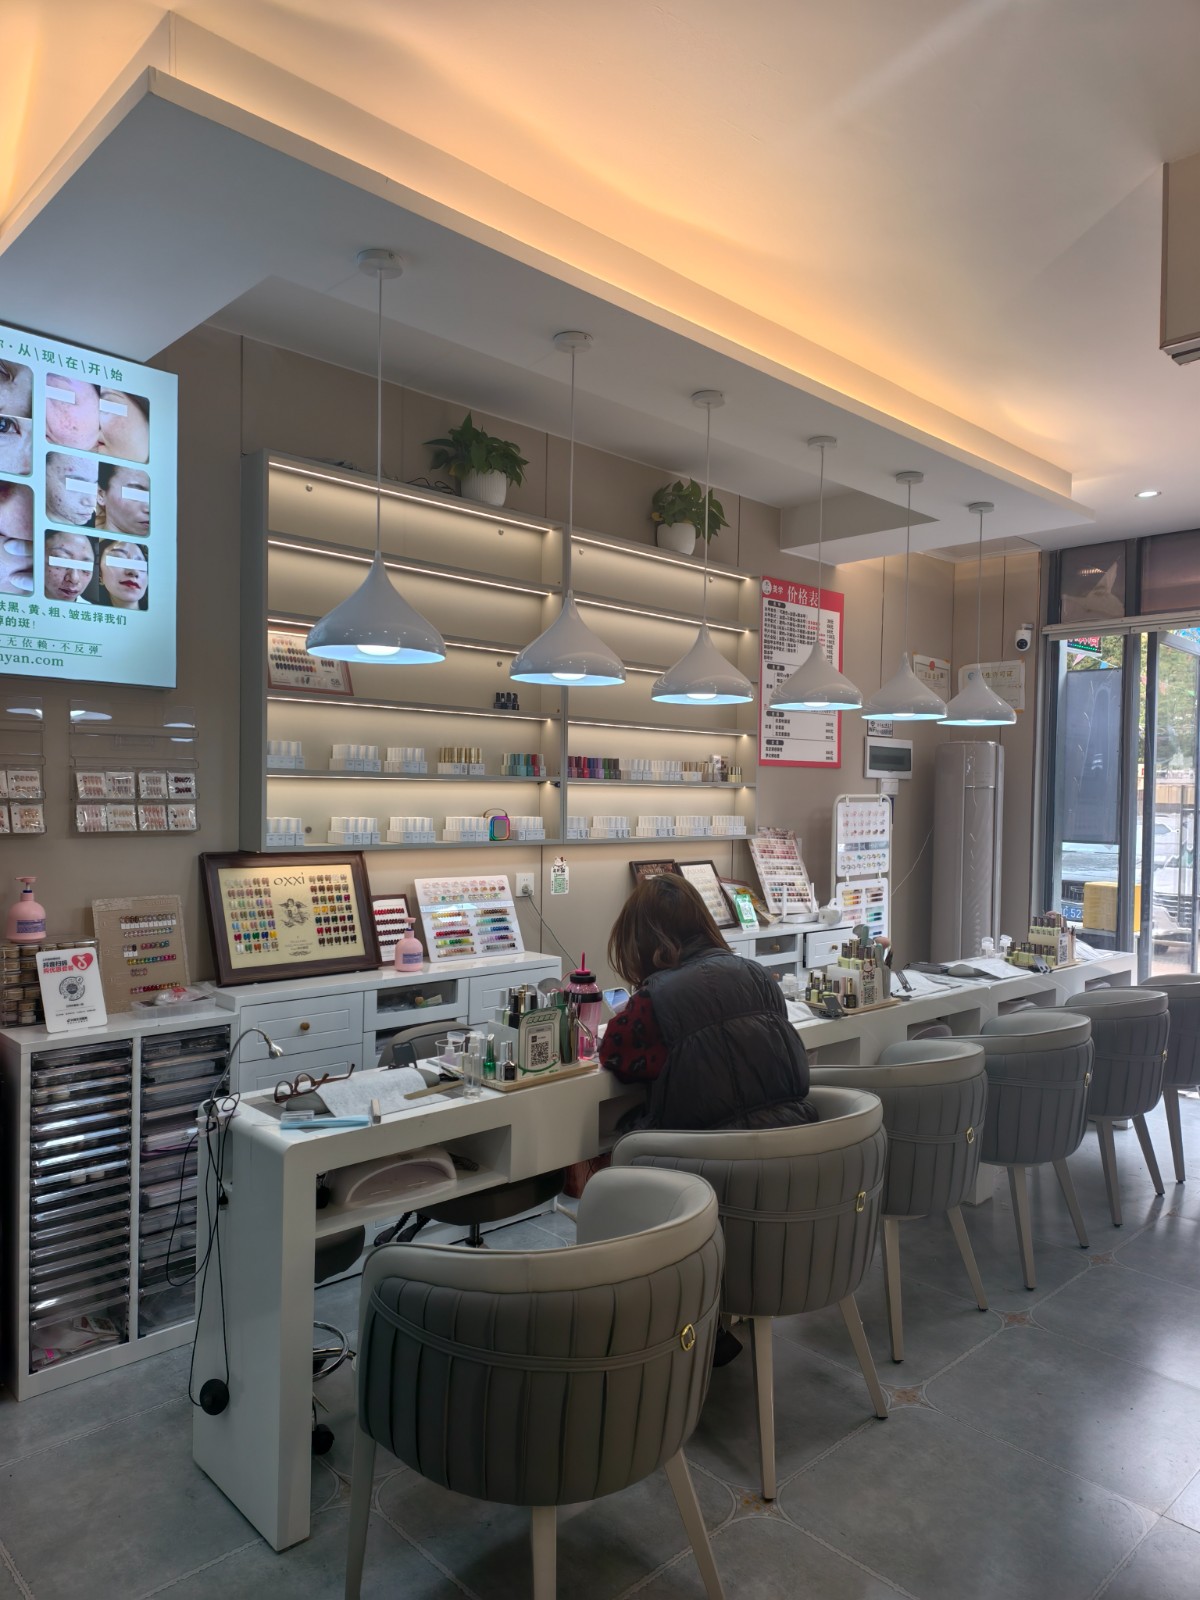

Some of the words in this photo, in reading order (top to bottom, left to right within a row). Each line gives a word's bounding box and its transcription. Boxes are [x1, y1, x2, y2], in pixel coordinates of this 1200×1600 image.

[787, 585, 818, 607] 价格表
[273, 872, 305, 887] oxxi
[1070, 908, 1084, 919] 52
